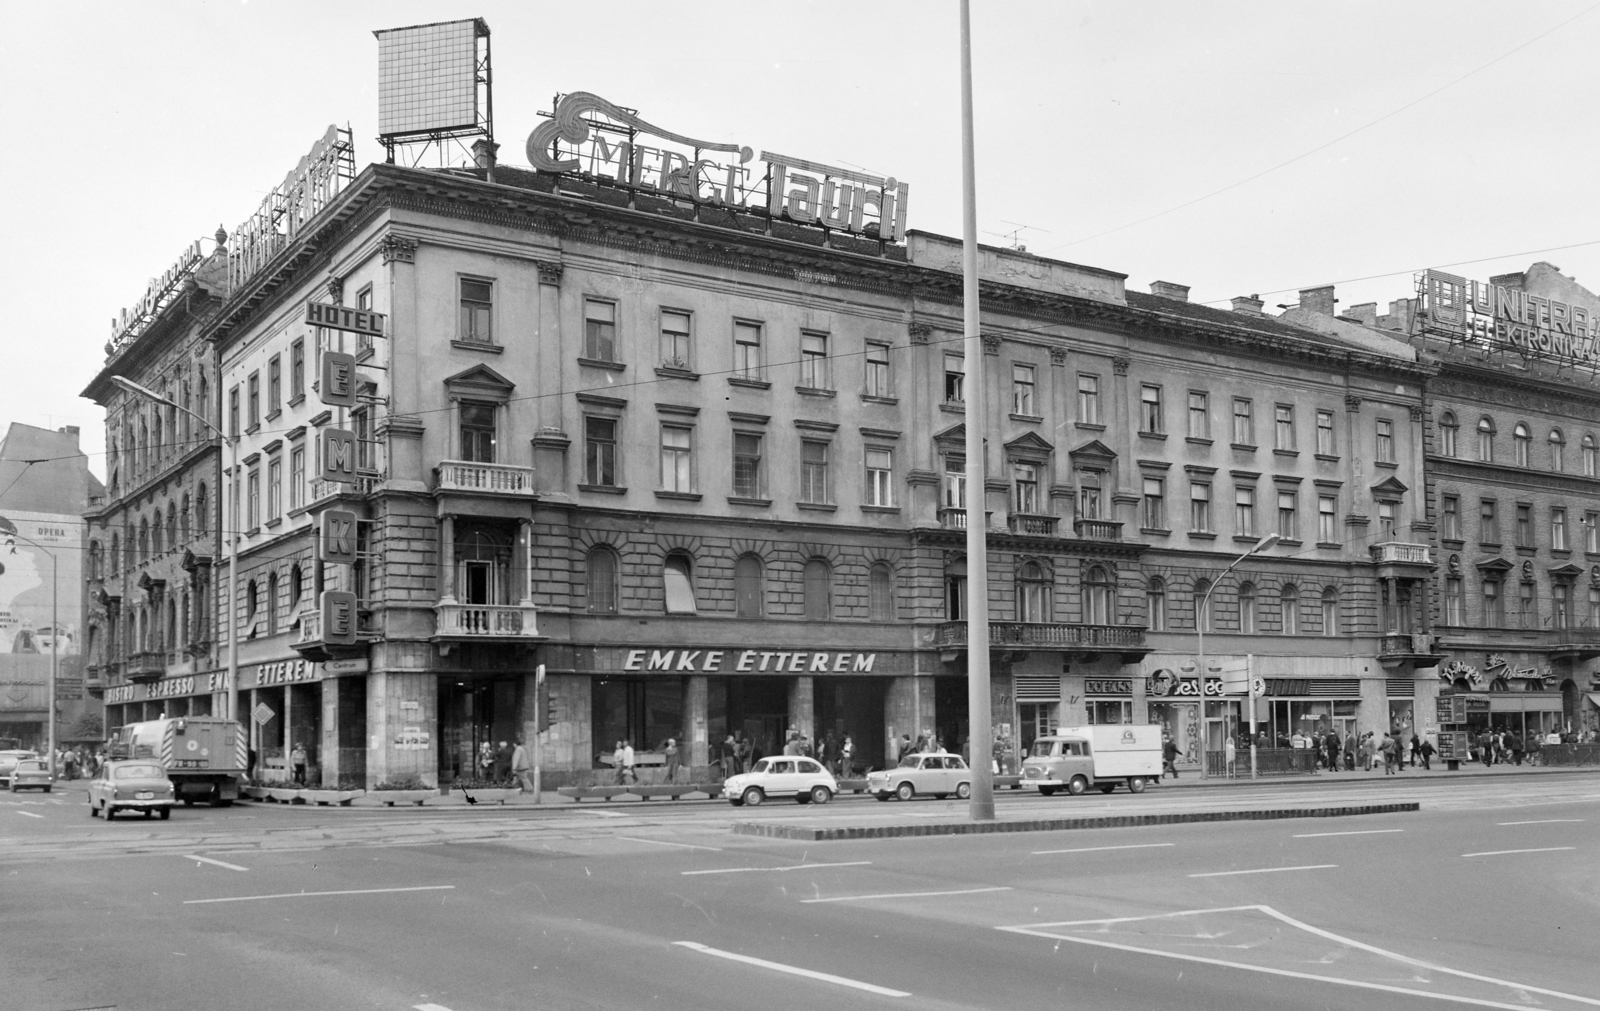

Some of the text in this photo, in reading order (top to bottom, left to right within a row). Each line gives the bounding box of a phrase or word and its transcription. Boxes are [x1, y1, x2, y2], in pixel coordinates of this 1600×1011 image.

[760, 150, 909, 243] Tauril
[155, 240, 202, 298] BULGARIA
[308, 302, 382, 334] HOTEL
[1471, 279, 1590, 338] UNITRA
[1471, 316, 1591, 361] ELEKTRONIKA
[38, 527, 65, 537] OPERA
[623, 648, 876, 673] EMKE ÉTTEREM
[107, 685, 134, 703] BISTRO
[146, 676, 194, 698] ESPRESSO
[208, 671, 230, 691] EMK
